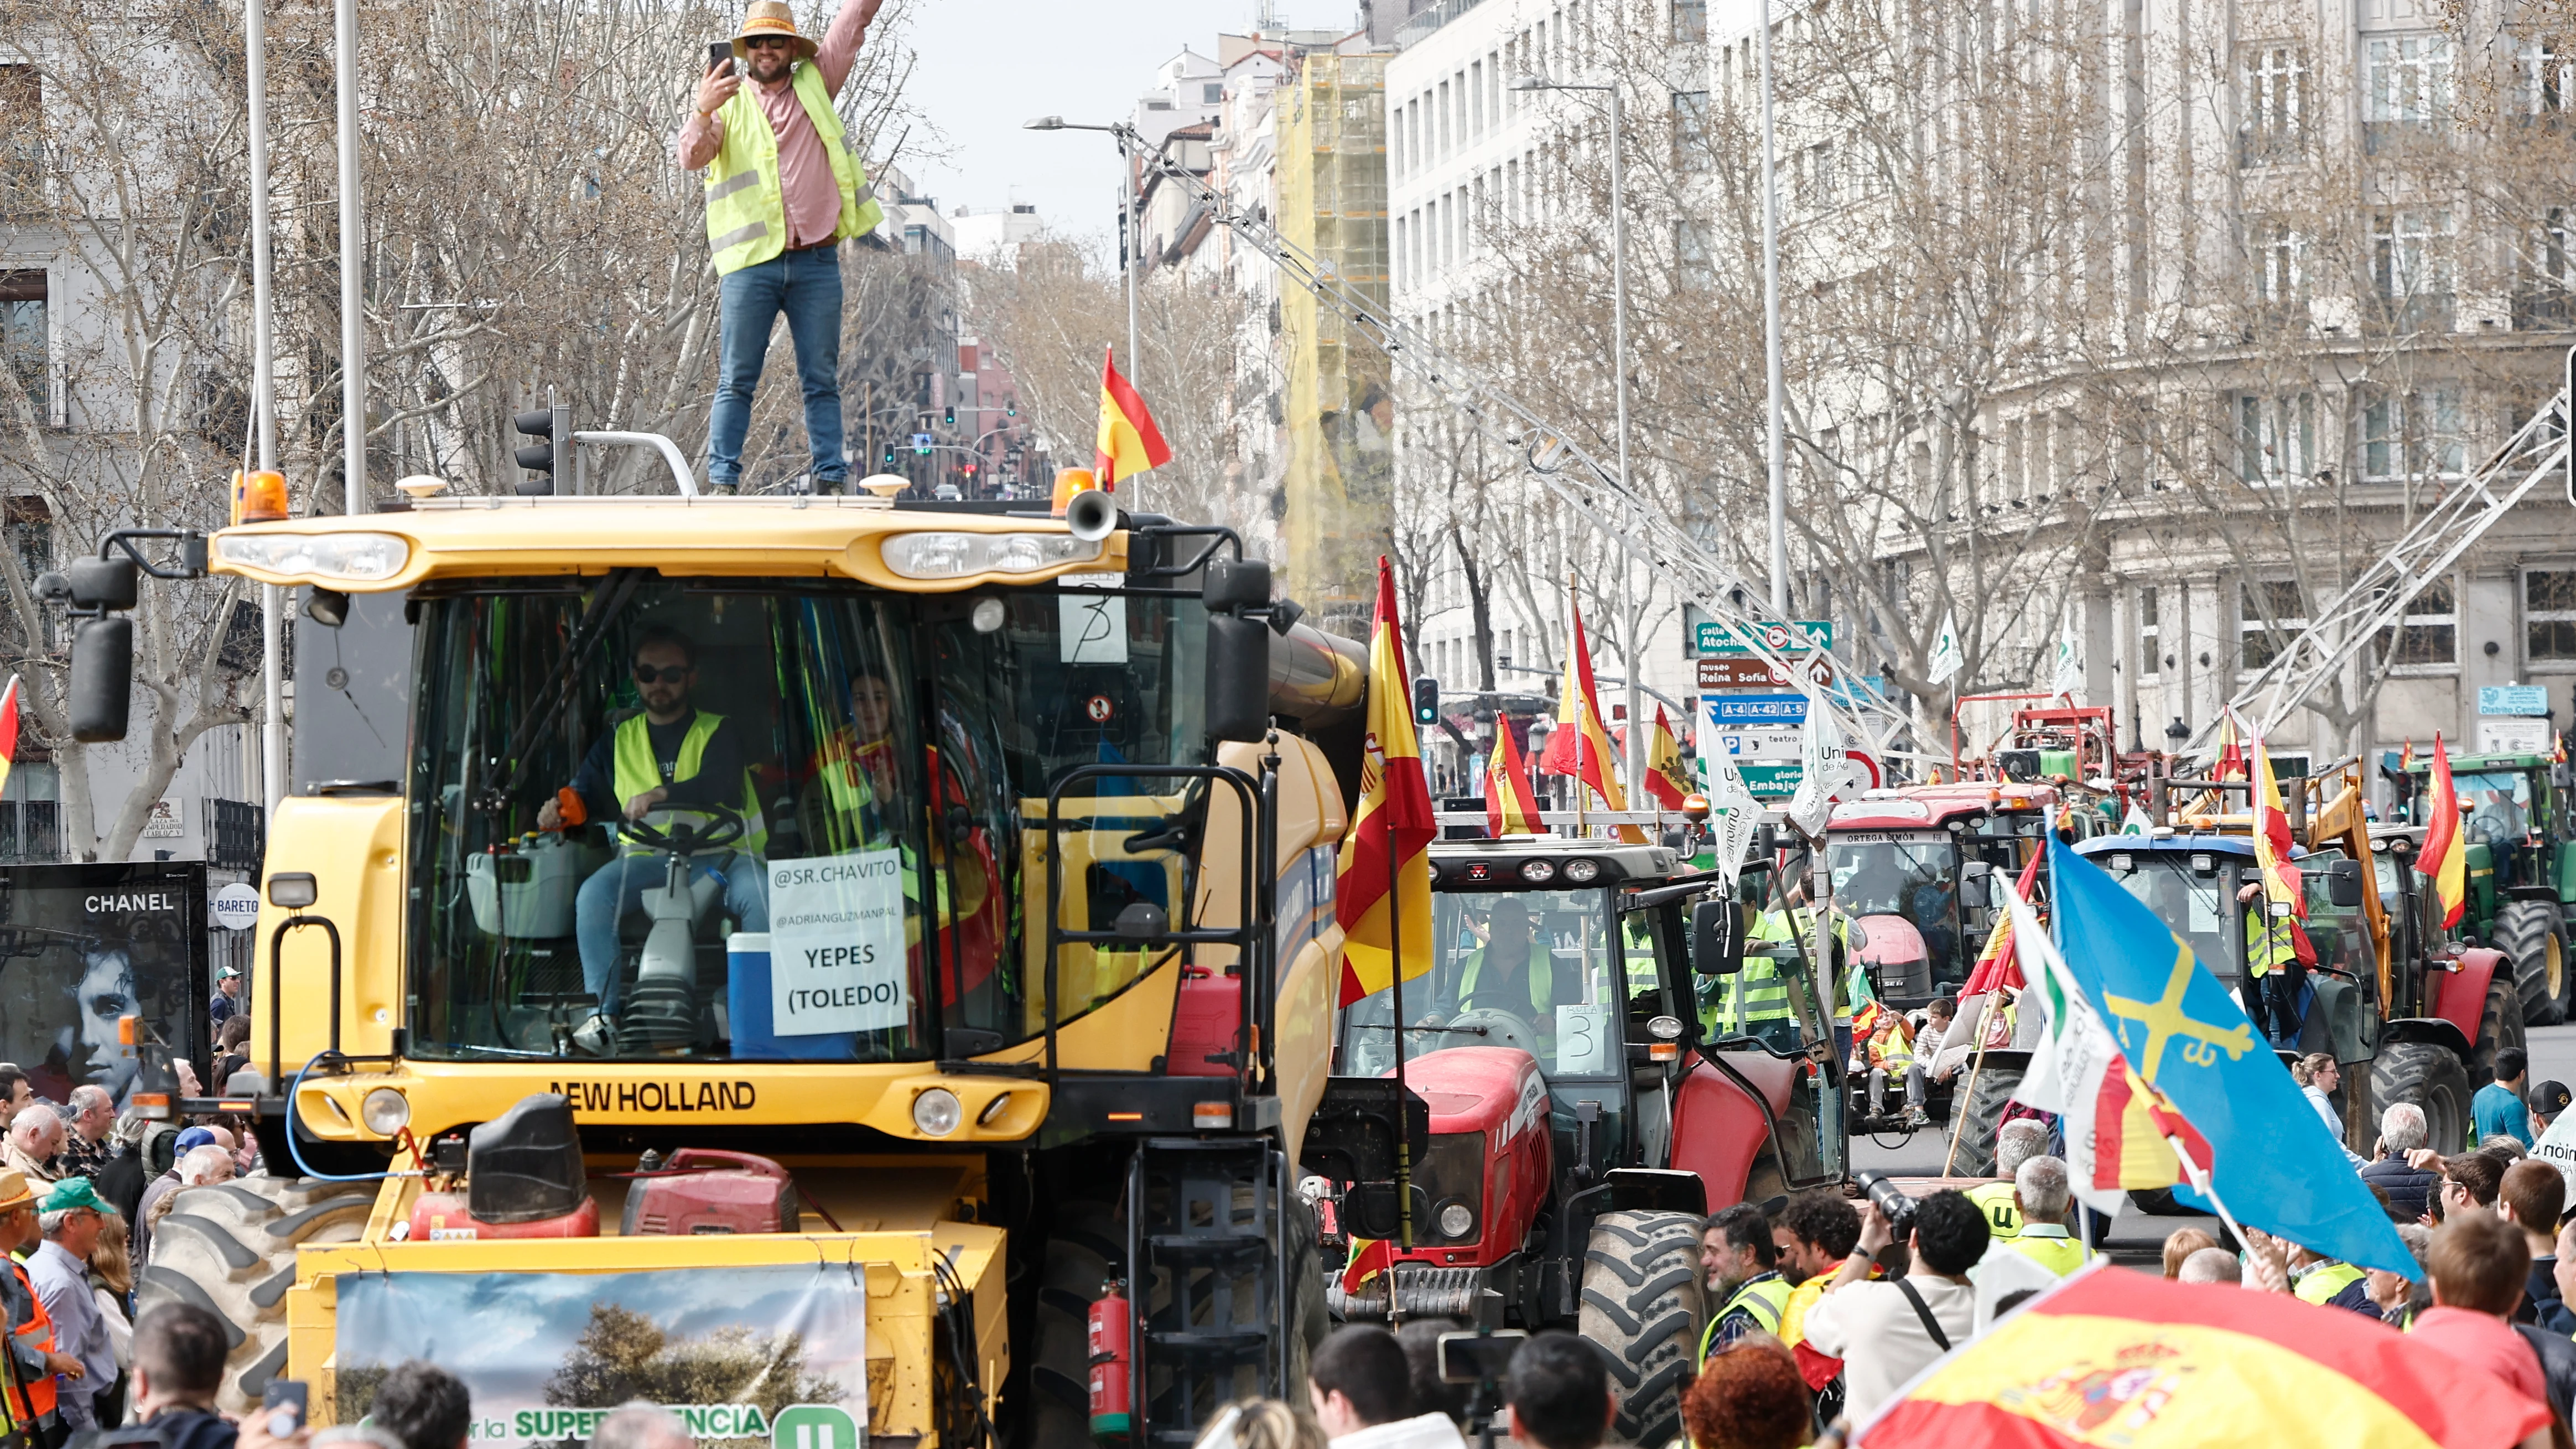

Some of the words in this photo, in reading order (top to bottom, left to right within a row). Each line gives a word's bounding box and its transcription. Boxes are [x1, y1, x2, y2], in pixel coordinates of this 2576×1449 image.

[1701, 626, 1725, 636] calle
[1700, 672, 1731, 683] Reina
[1725, 704, 1744, 714] A-4
[1751, 704, 1777, 714] A-42
[1783, 703, 1803, 713] A-5
[1886, 832, 1915, 841] SIMÓN
[775, 860, 896, 889] @SR.CHAVITO
[2376, 860, 2391, 885] 3
[85, 893, 174, 913] CHANEL
[217, 900, 259, 913] BARETO
[776, 906, 897, 928] @ADRIANGUZMANPAL
[804, 943, 875, 969] YEPES
[788, 980, 899, 1015] (TOLEDO)
[1566, 1005, 1598, 1015] RUTA
[1569, 1015, 1594, 1058] 3
[617, 1082, 755, 1112] HOLLAND
[485, 1418, 505, 1438] la
